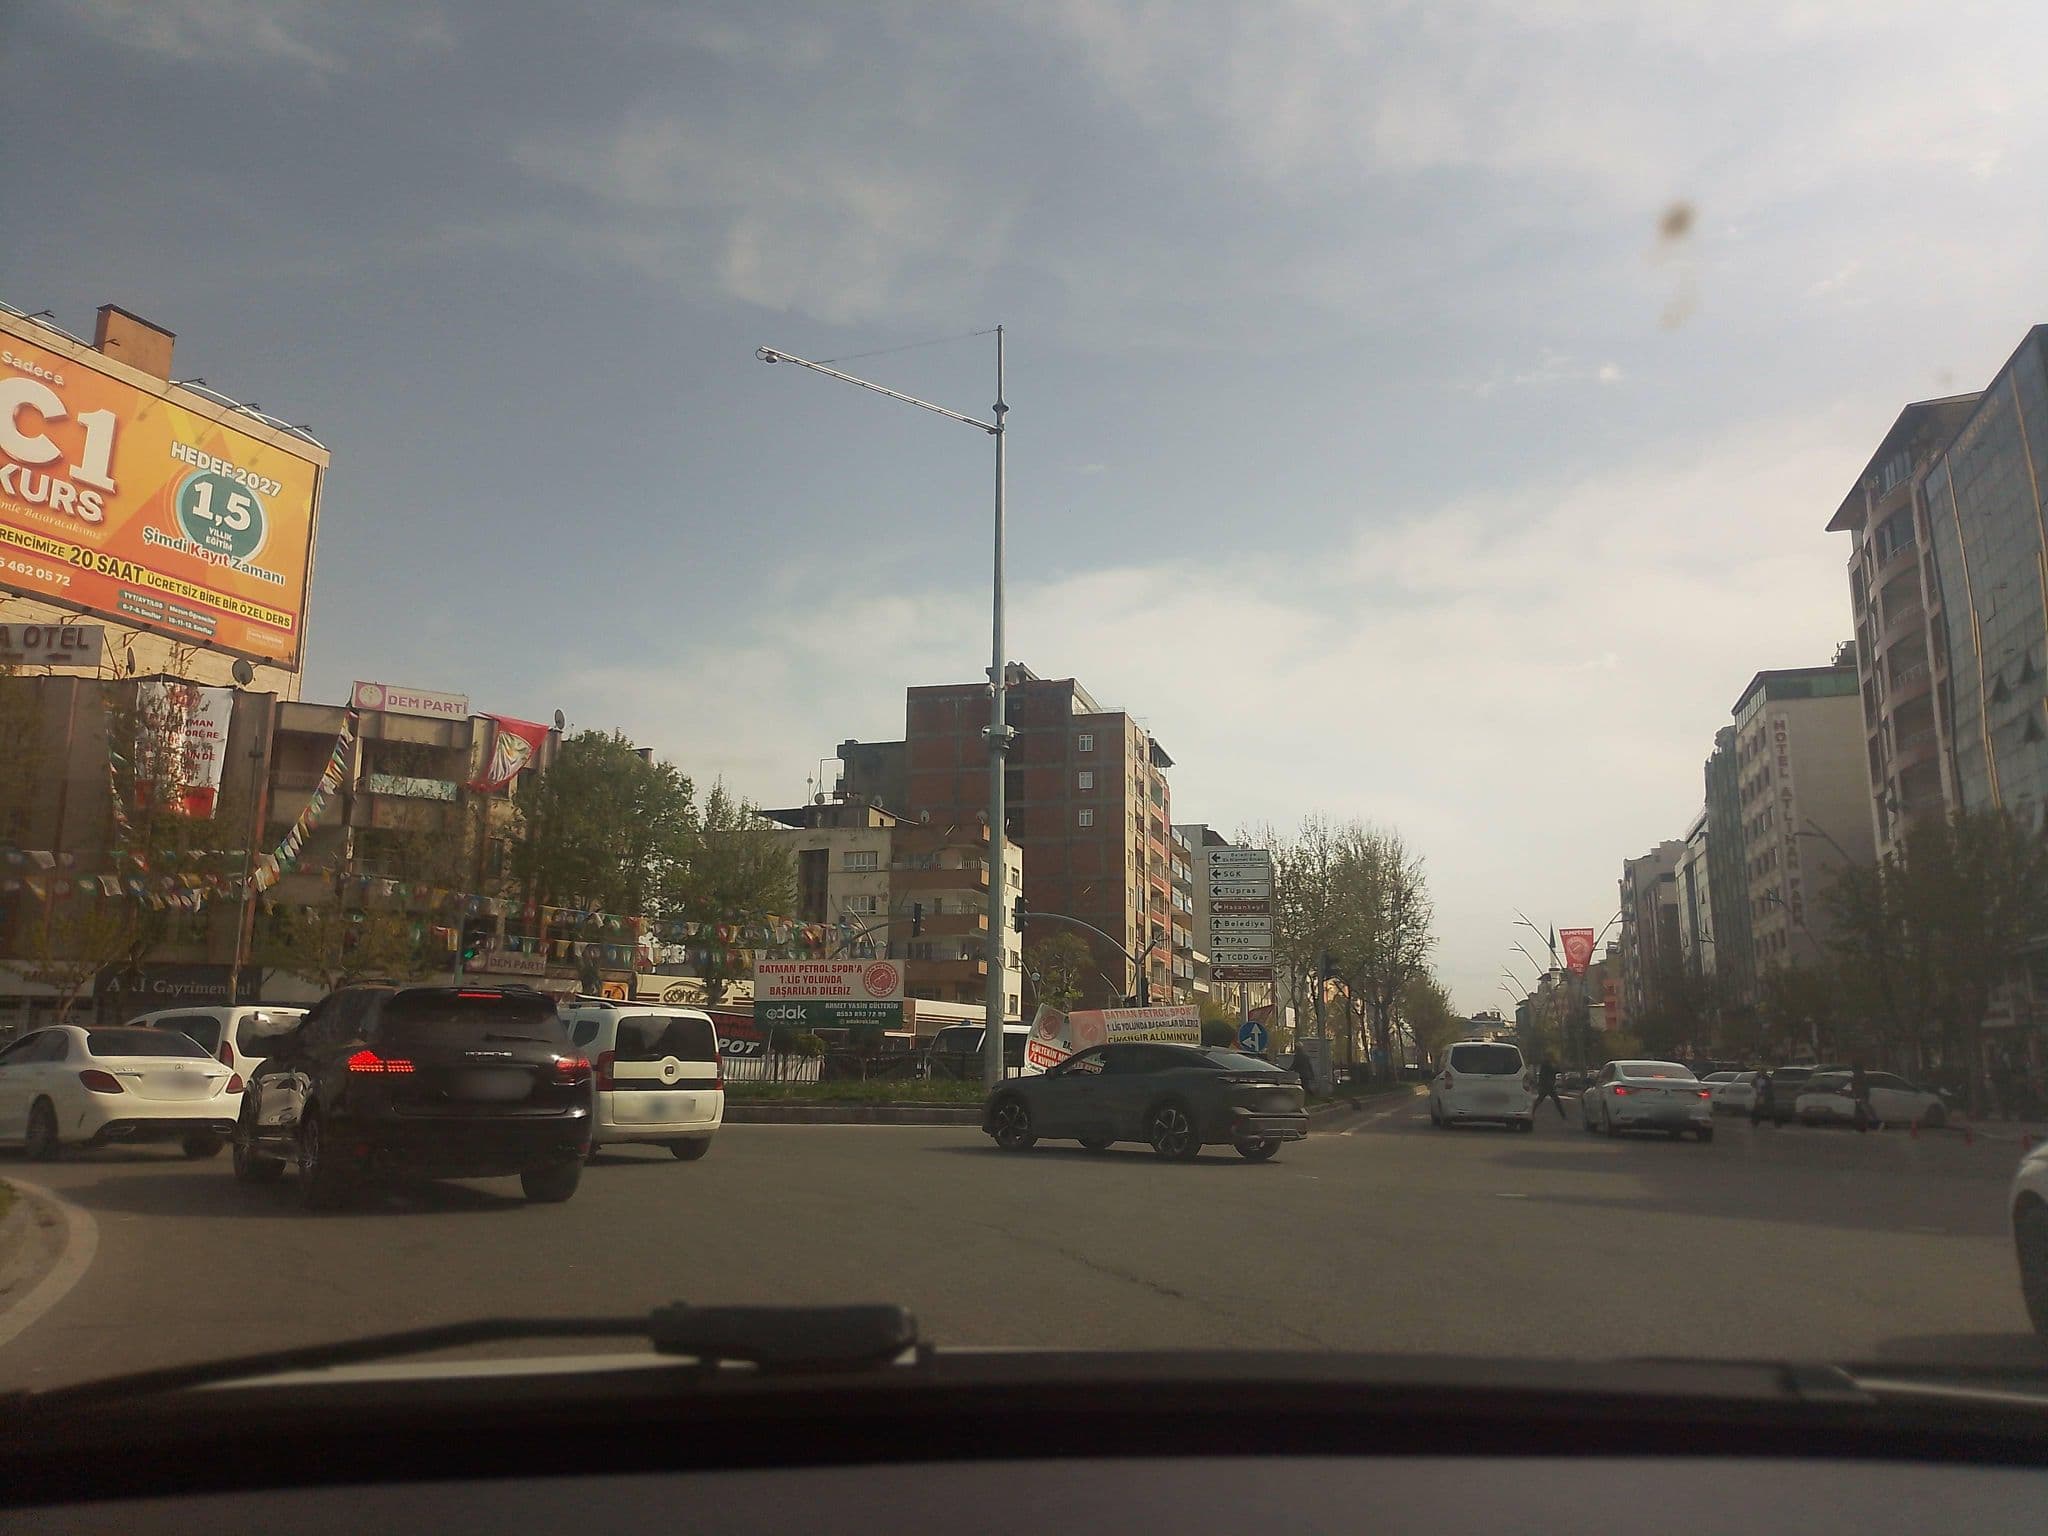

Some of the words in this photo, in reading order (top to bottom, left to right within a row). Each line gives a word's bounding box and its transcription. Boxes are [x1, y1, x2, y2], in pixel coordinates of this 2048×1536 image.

[2, 351, 64, 386] Sadece
[171, 441, 233, 478] HEDEF
[235, 467, 282, 497] 2027
[192, 481, 251, 531] 1,5
[209, 527, 233, 542] YILLIK
[143, 526, 188, 554] Şimdi
[190, 542, 229, 566] Kayıt
[231, 556, 286, 585] Zamanı
[0, 528, 65, 558] RENCİMİZE
[69, 546, 94, 569] 20
[97, 554, 144, 584] SAAT
[147, 572, 198, 599] ÜCRETSİZ
[200, 589, 221, 607] BİRE
[222, 597, 239, 612] BİR
[240, 602, 264, 620] ÖZEL
[266, 611, 291, 628] DERS
[7, 561, 33, 576] 462
[36, 568, 53, 581] 05
[55, 573, 71, 587] 72
[23, 625, 88, 650] OTEL
[388, 695, 419, 709] DEM
[423, 699, 468, 715] PARTİ
[1774, 719, 1788, 779] HOTEL
[1223, 870, 1242, 878] SGK
[1224, 904, 1264, 912] Hasankeyf
[1224, 919, 1265, 929] Belediye
[1227, 953, 1249, 961] TCDD
[759, 964, 796, 973] BATMAN
[799, 964, 829, 973] PETROL
[831, 964, 863, 973] SPOR'A
[803, 975, 842, 984] YOLUNDA
[152, 979, 250, 999] Gayrimenul
[769, 985, 818, 997] BAŞARILAR
[1104, 1009, 1138, 1020] BATMAN
[1138, 1008, 1169, 1019] PETROL
[718, 1037, 761, 1054] POT
